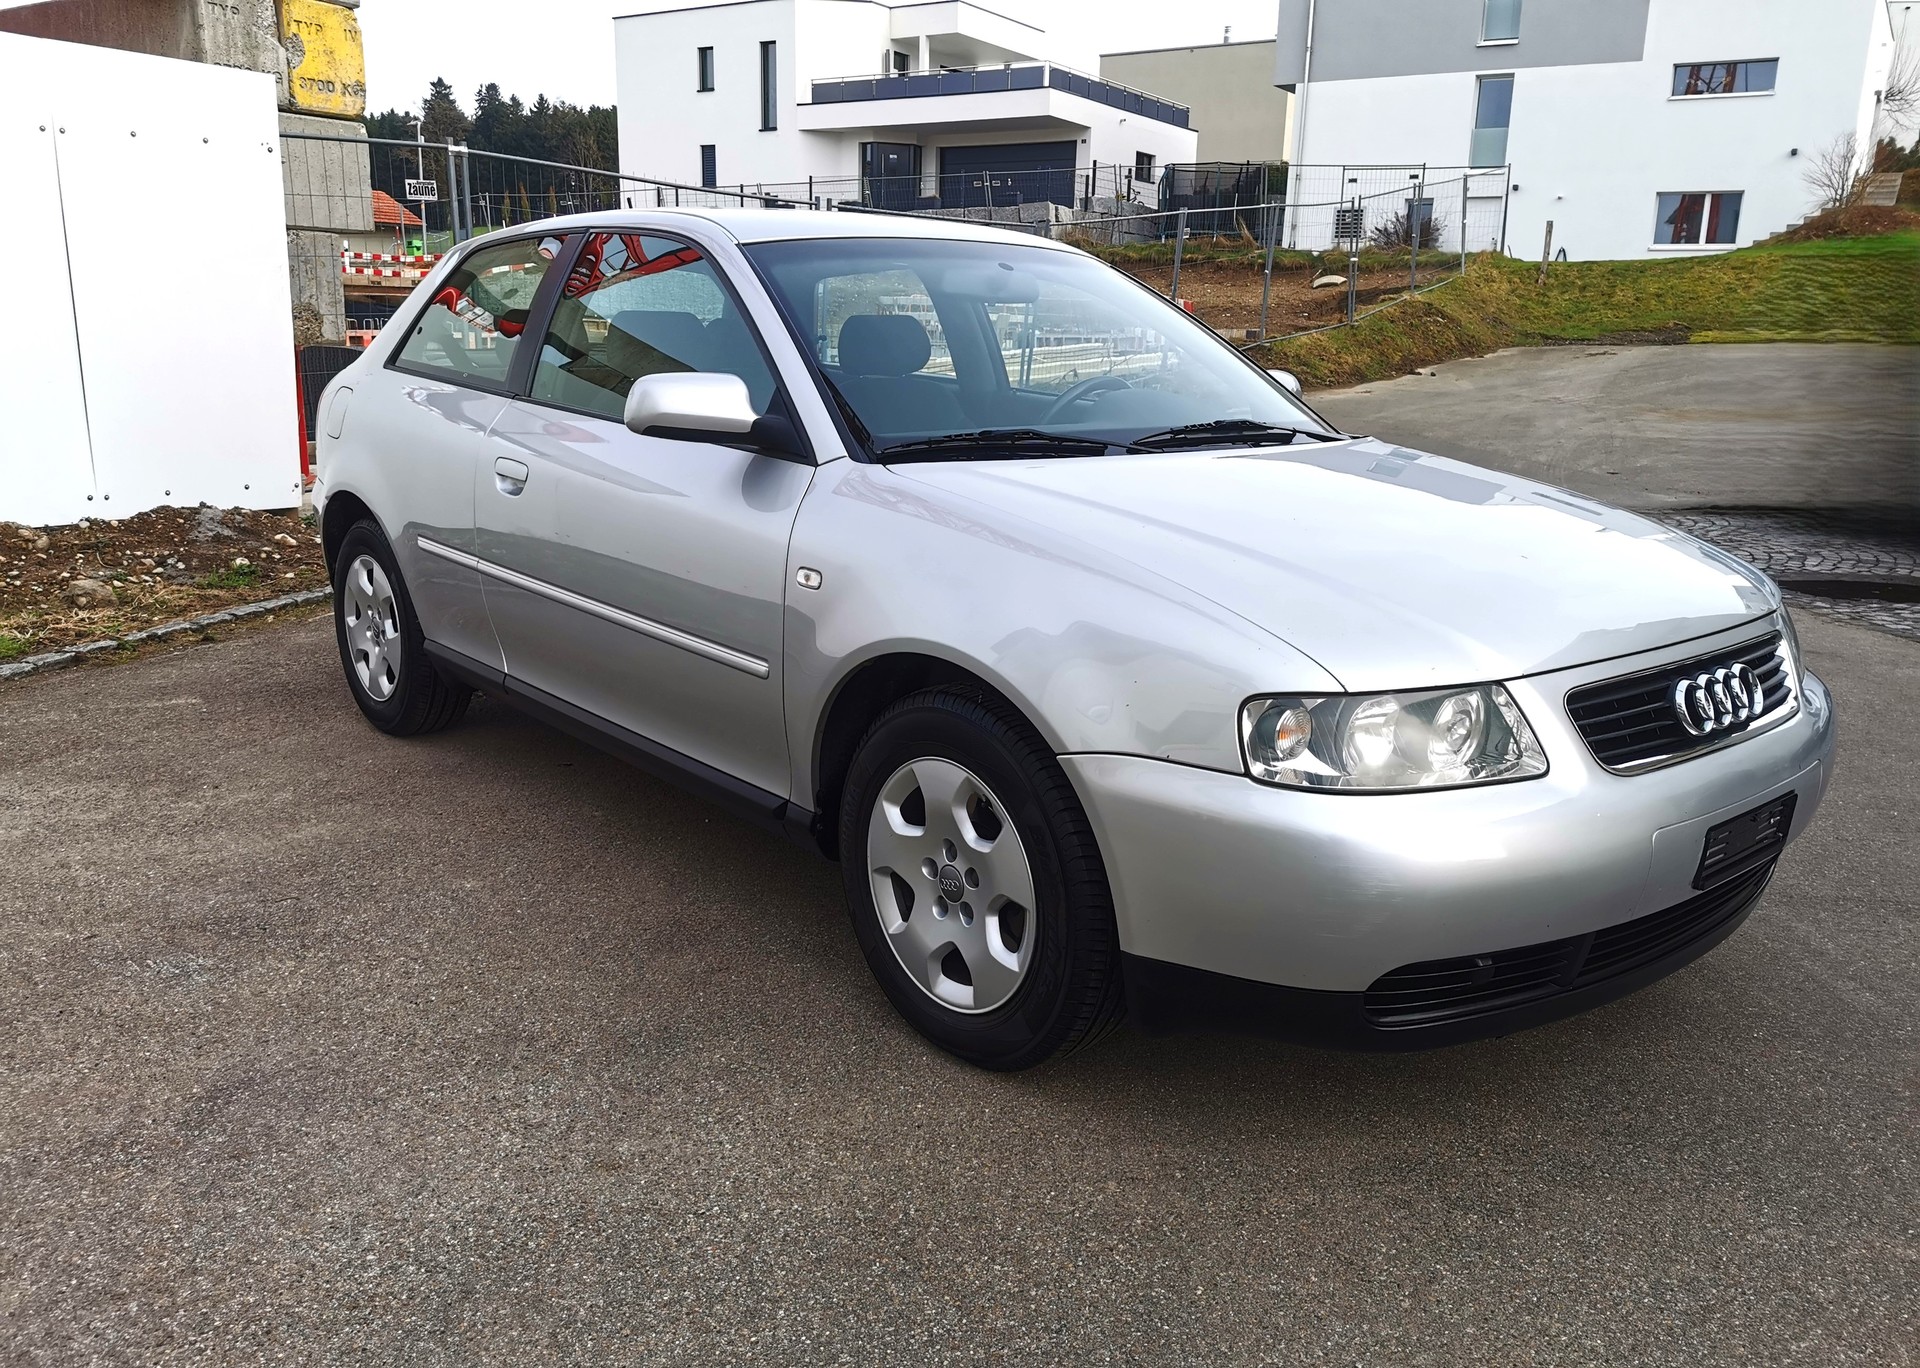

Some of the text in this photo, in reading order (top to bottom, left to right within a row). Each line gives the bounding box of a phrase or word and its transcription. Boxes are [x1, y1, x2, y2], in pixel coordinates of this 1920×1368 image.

[207, 1, 240, 19] TYP
[293, 19, 358, 43] TYP IV
[298, 76, 336, 93] 3700
[407, 182, 436, 197] Zäune
